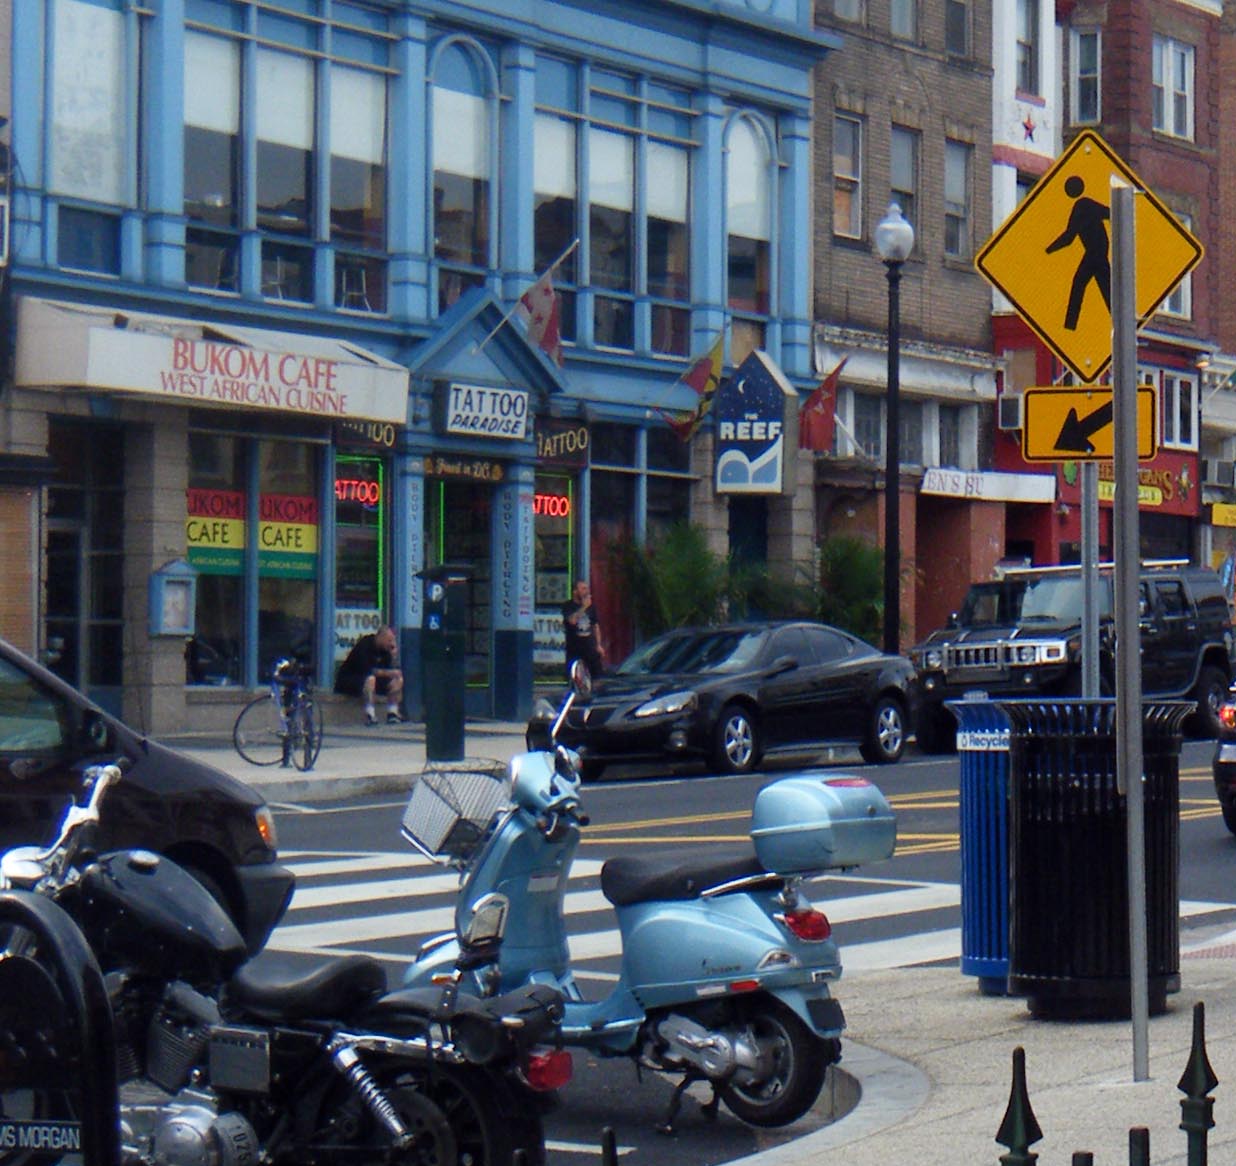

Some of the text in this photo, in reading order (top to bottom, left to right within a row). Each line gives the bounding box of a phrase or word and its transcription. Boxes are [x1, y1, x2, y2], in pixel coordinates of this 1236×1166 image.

[173, 337, 338, 391] BUKOM CAFE
[161, 371, 348, 414] WEST AFRICAN CUISINE
[452, 387, 526, 417] TATTOO
[450, 413, 523, 434] PARADISE
[720, 422, 782, 440] REEF
[335, 479, 380, 504] ATTOO
[261, 498, 314, 524] UKOM
[533, 493, 570, 517] ATTOO
[186, 521, 230, 544] CAFE
[262, 526, 303, 548] CAFE
[336, 614, 380, 631] ATTOO
[19, 1126, 81, 1149] MORGAN
